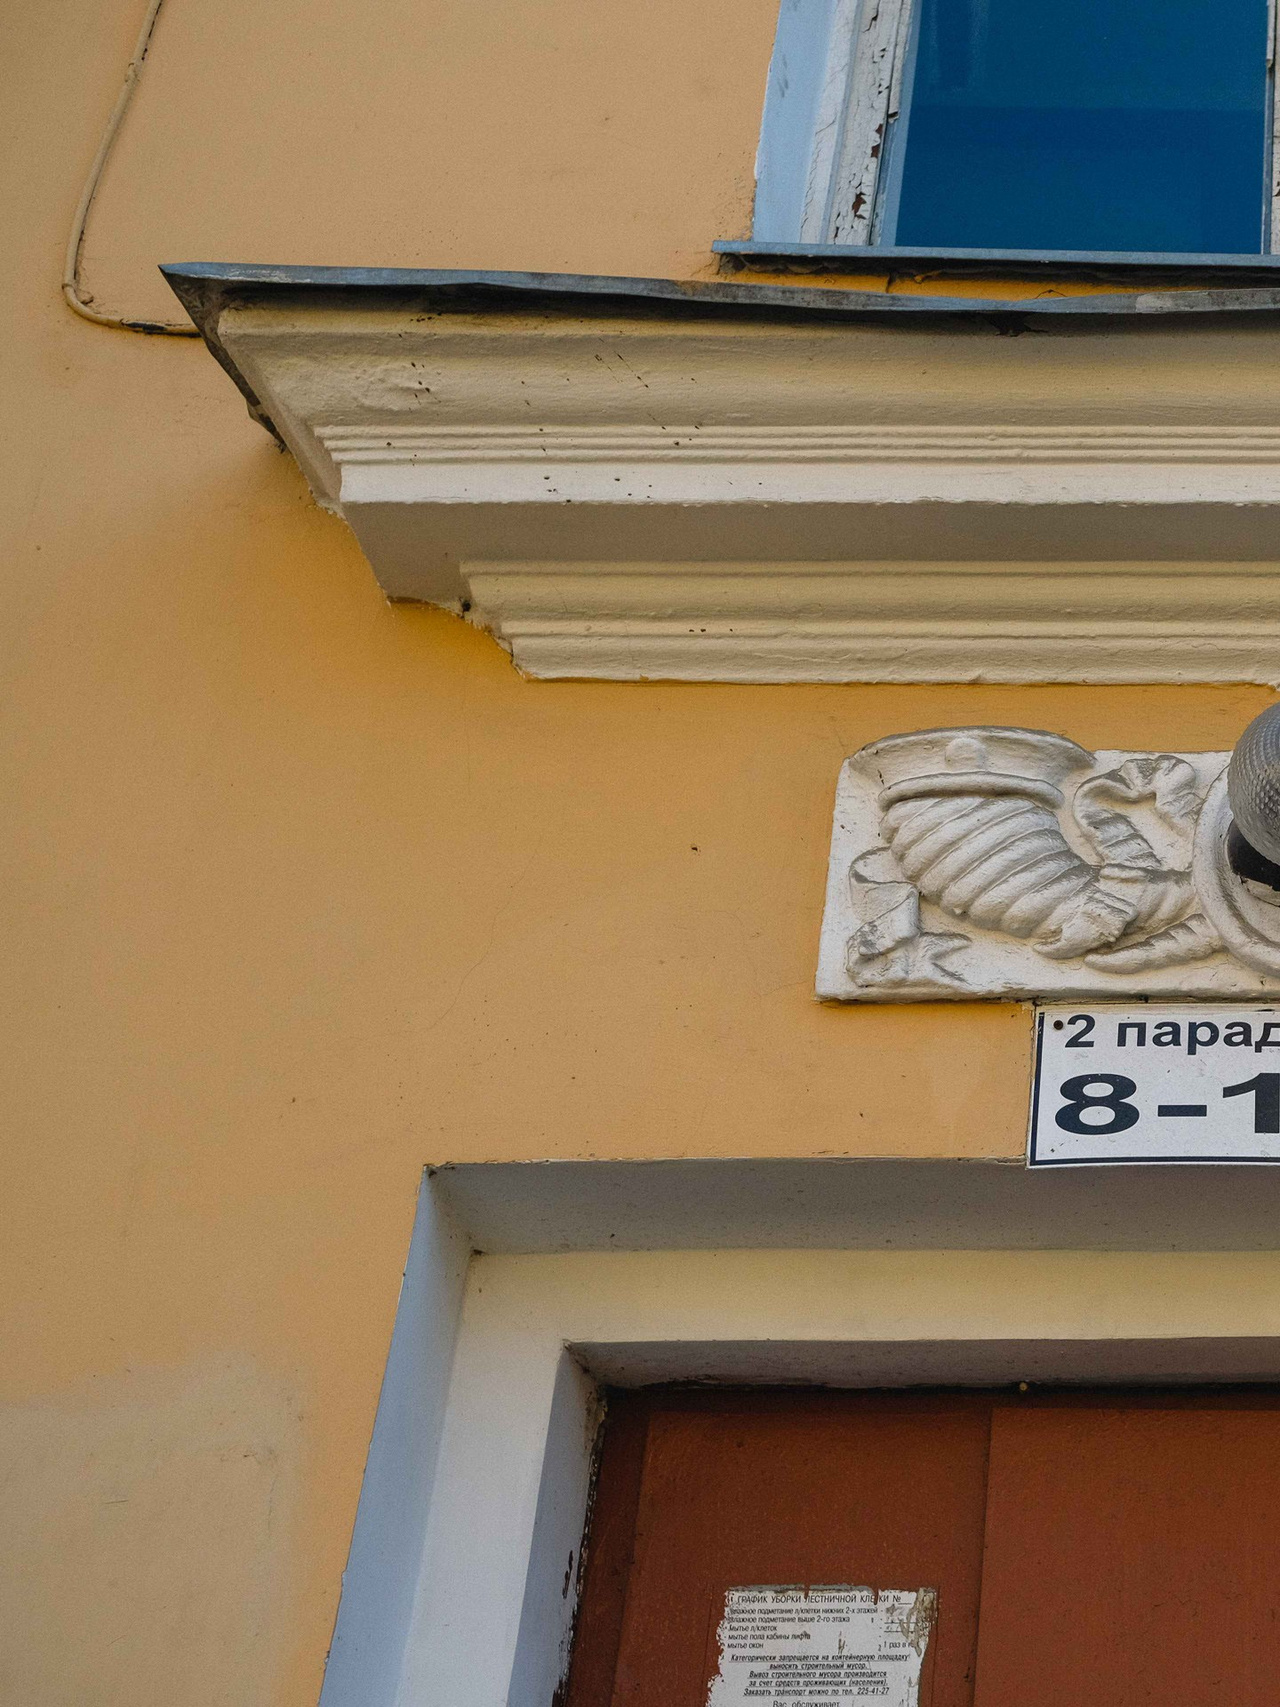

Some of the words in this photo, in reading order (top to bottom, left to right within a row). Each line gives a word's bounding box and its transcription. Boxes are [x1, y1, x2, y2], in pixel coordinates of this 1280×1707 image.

[1064, 1014, 1096, 1049] 2
[737, 1595, 768, 1603] ГРАФИК
[771, 1595, 802, 1603] УБОРКИ
[860, 1594, 889, 1603] КЛЕКИ
[757, 1608, 794, 1616] подметание
[856, 1606, 878, 1614] этажей
[758, 1616, 796, 1624] подметание
[730, 1654, 776, 1662] Категорически
[778, 1654, 819, 1662] запрещается
[831, 1653, 875, 1661] контейнерную
[801, 1662, 844, 1670] строительный
